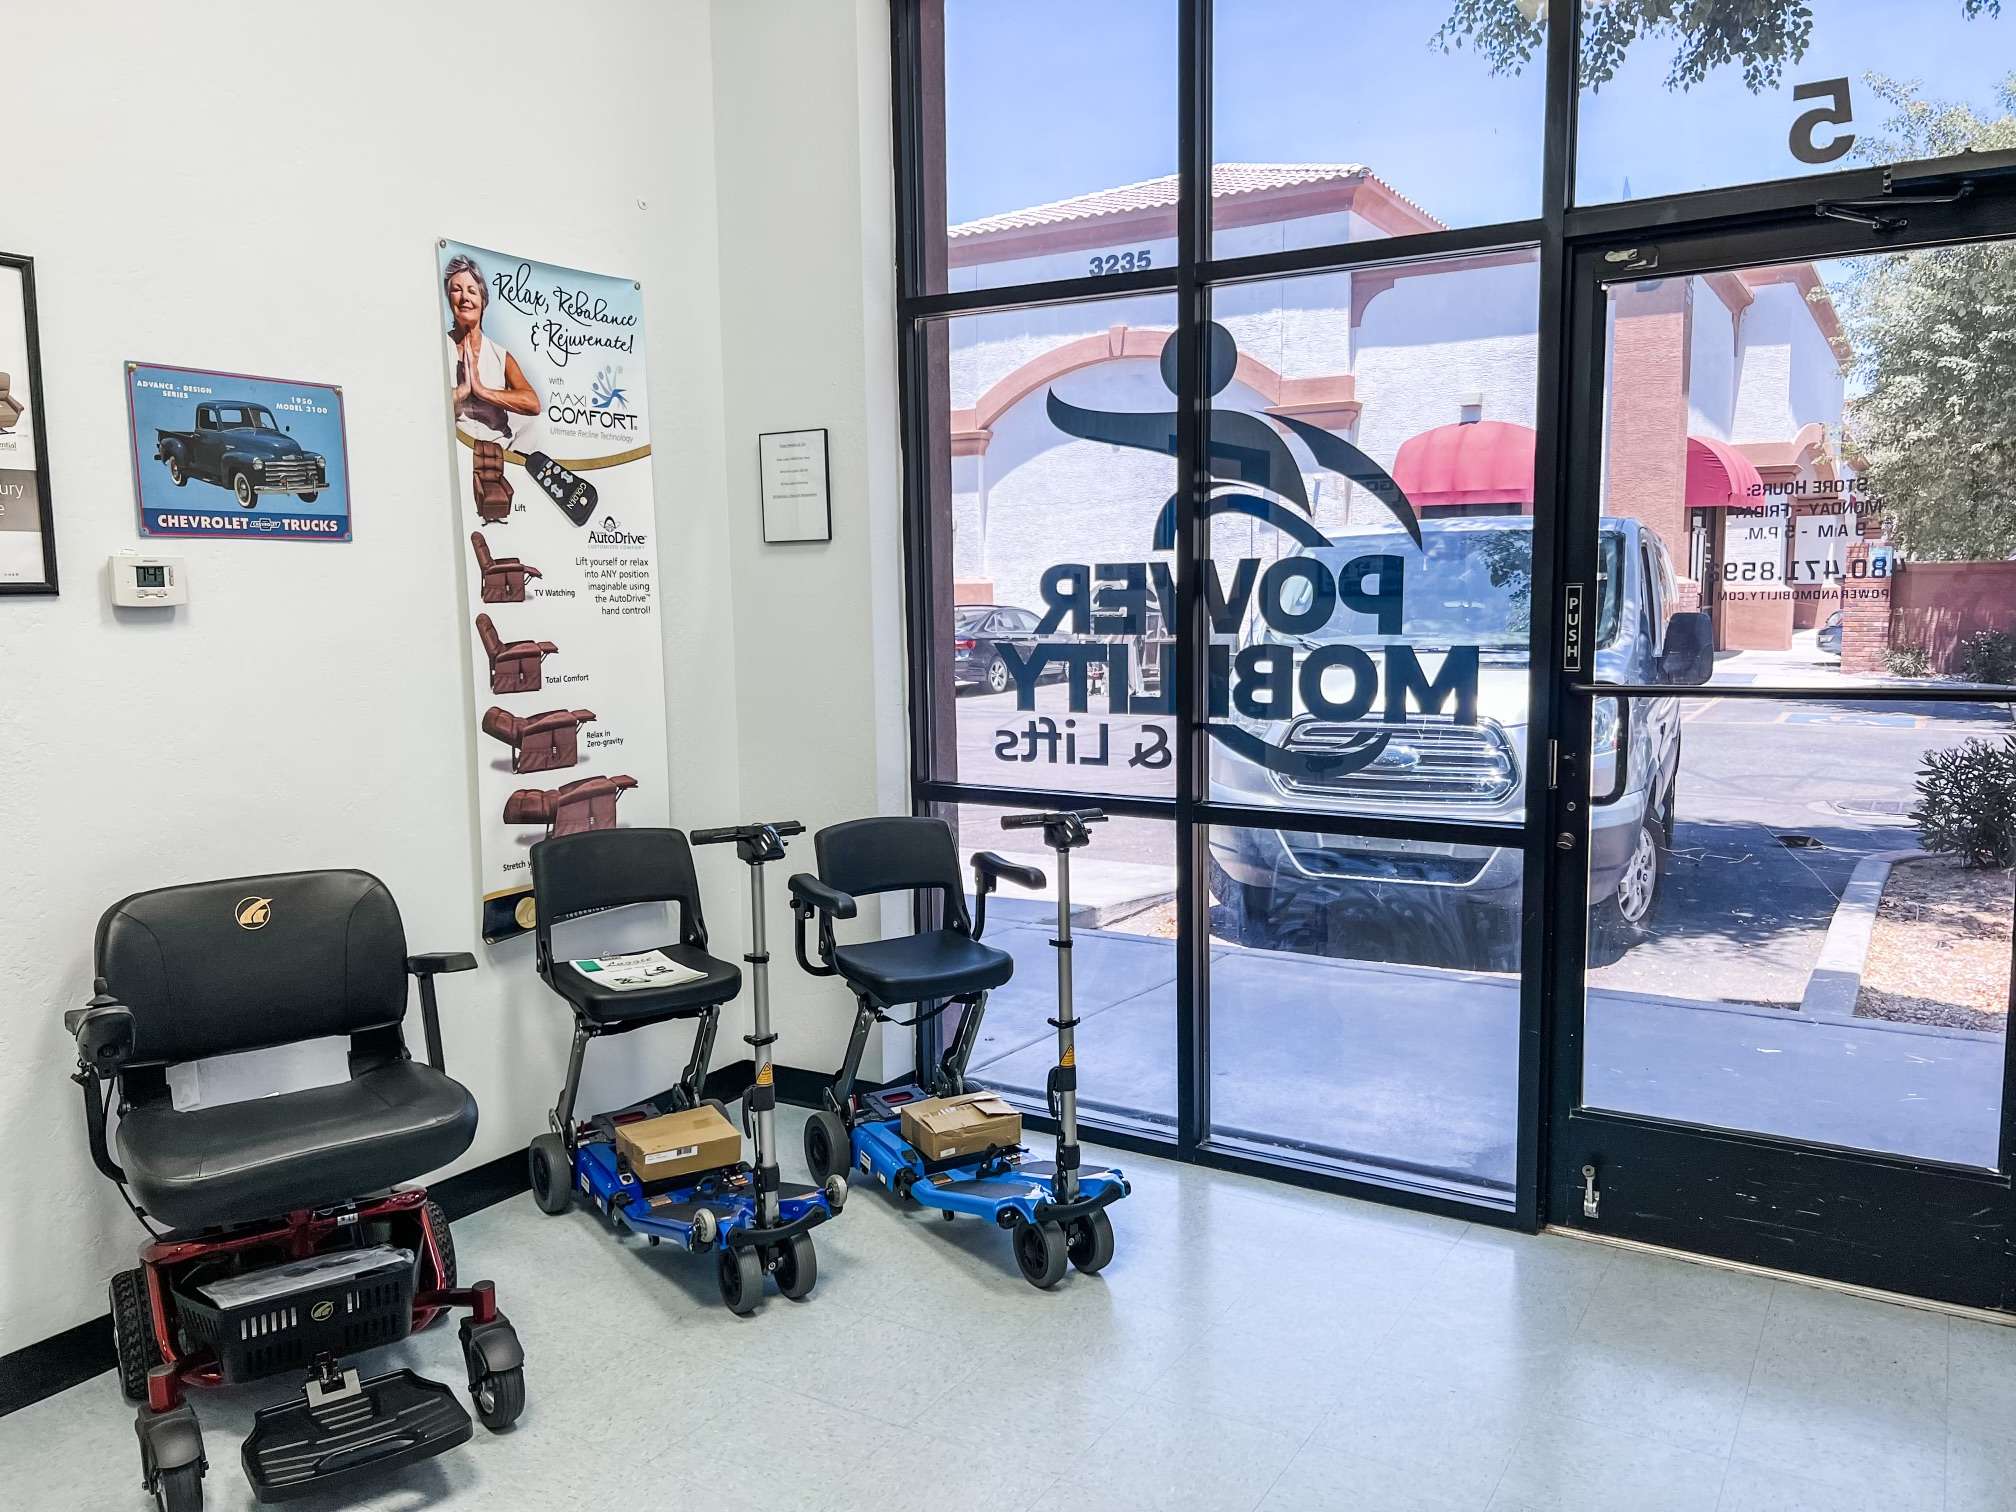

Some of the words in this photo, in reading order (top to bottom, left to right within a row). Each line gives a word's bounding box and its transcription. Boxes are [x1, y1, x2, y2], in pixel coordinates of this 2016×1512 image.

[1089, 249, 1152, 277] 3235
[493, 263, 549, 316] Relax,
[553, 286, 637, 327] Rebalance
[543, 319, 634, 367] Rejuvenate!
[137, 380, 174, 391] ADVANCE
[183, 385, 212, 394] DESIGN
[162, 390, 188, 399] SERIES
[550, 391, 587, 407] MAXI
[276, 403, 303, 412] MODEL
[600, 432, 634, 444] Technology
[567, 482, 587, 510] GOLDEN
[514, 503, 526, 512] Lift
[157, 514, 249, 531] CHEVROLET
[282, 519, 338, 532] TRUCKS
[576, 556, 588, 566] Lift
[589, 557, 618, 568] yourself
[630, 558, 649, 566] relax
[584, 570, 598, 578] into
[601, 570, 617, 578] ANY
[620, 570, 649, 579] position
[588, 582, 627, 592] imaginable
[630, 583, 650, 592] using
[534, 589, 543, 597] TV
[545, 589, 576, 599] Watching
[595, 594, 607, 603] the
[601, 606, 619, 615] hand
[622, 606, 651, 615] control!
[1567, 597, 1579, 657] PUSH
[545, 676, 562, 684] Total
[563, 674, 589, 683] Comfort
[586, 731, 604, 739] Relax
[587, 737, 624, 748] Zero-gravity
[503, 860, 526, 872] Stretch
